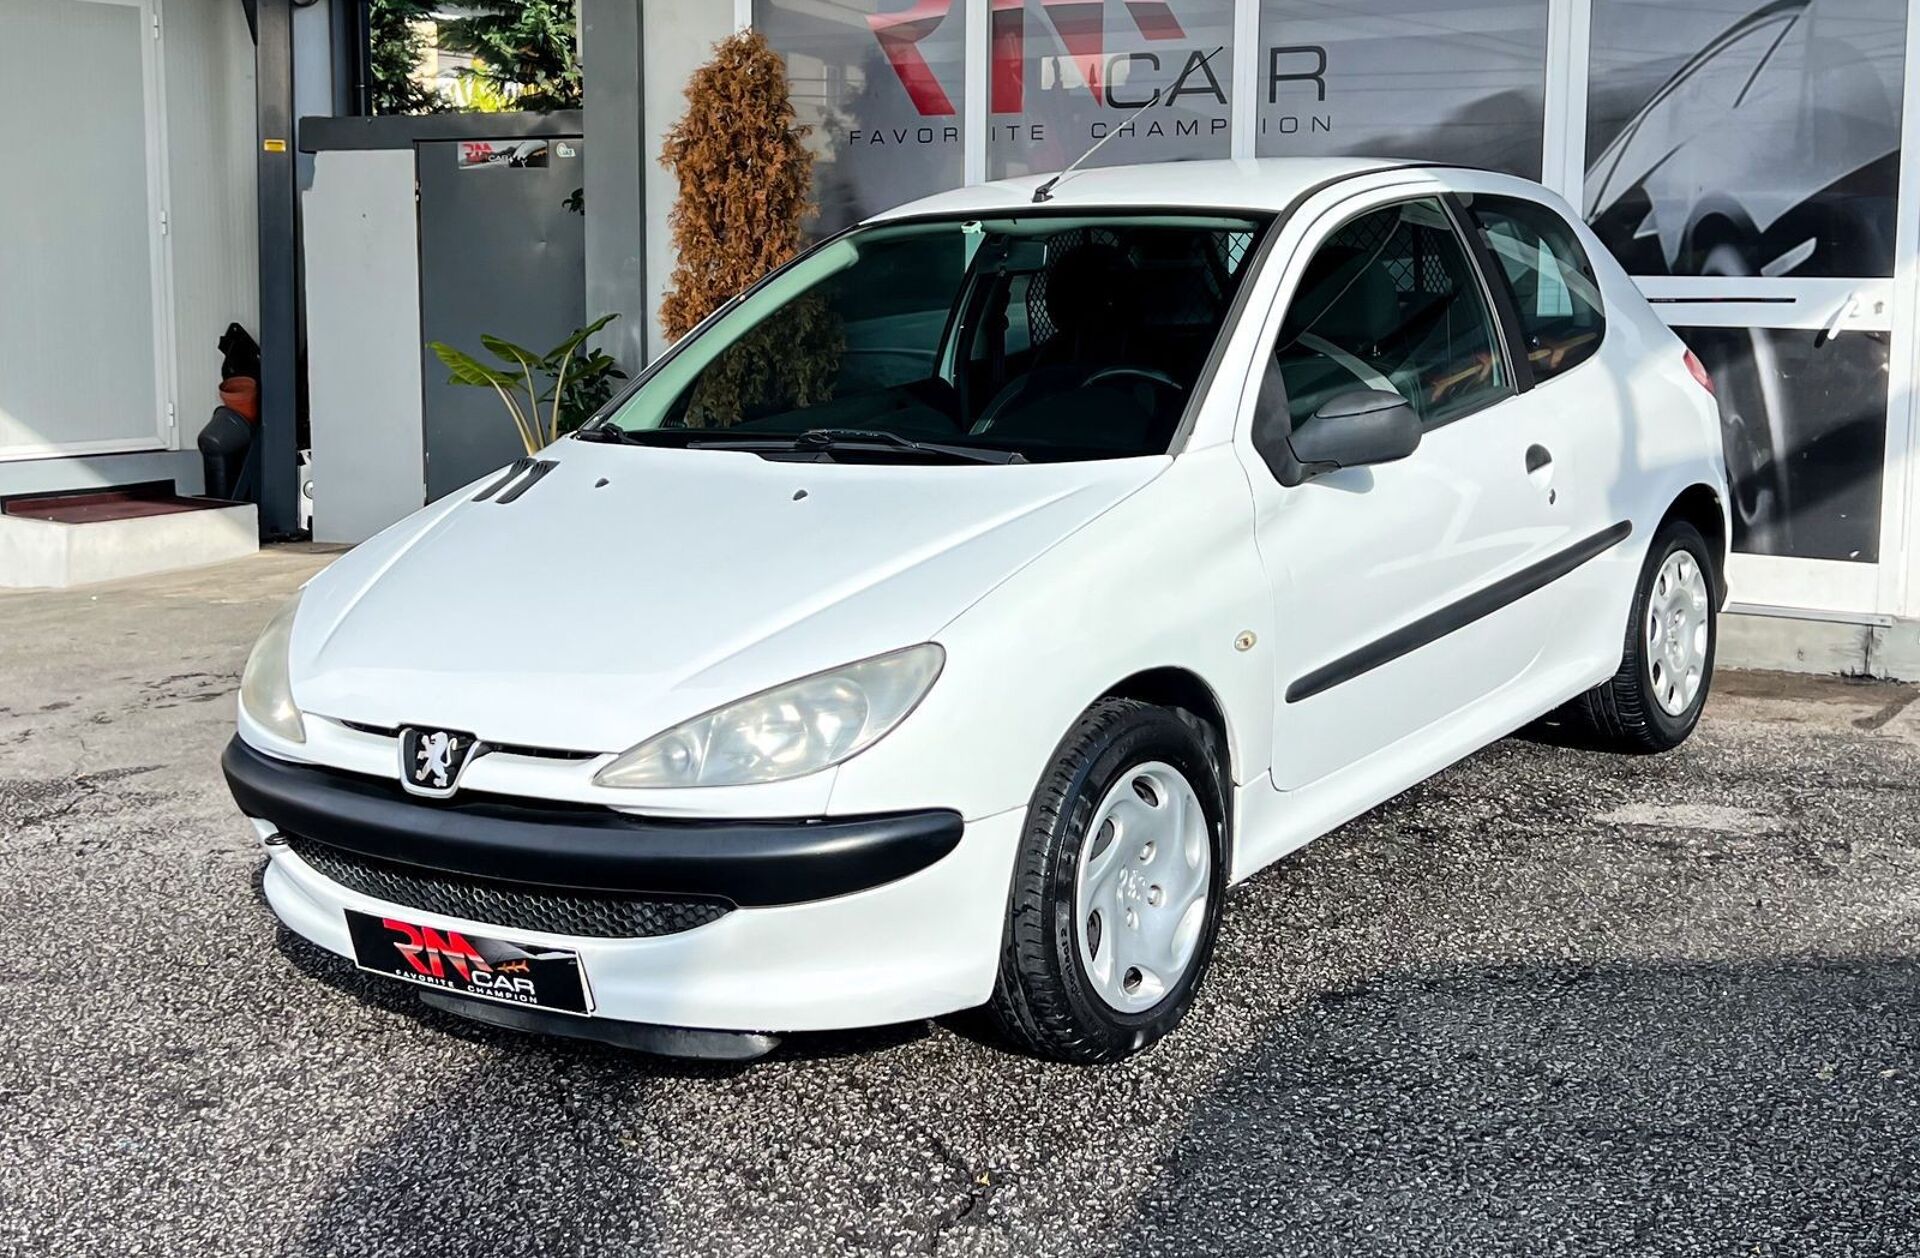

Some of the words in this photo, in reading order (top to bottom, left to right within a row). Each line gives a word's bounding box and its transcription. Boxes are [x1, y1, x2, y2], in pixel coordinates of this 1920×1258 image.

[1105, 45, 1328, 109] CAR
[848, 123, 1045, 146] FAVORITE
[1090, 114, 1333, 140] CHAMPION
[383, 917, 494, 982] RM
[395, 969, 455, 989] FAVORITE
[467, 984, 538, 1004] CHAMPION
[472, 970, 536, 995] CAR
